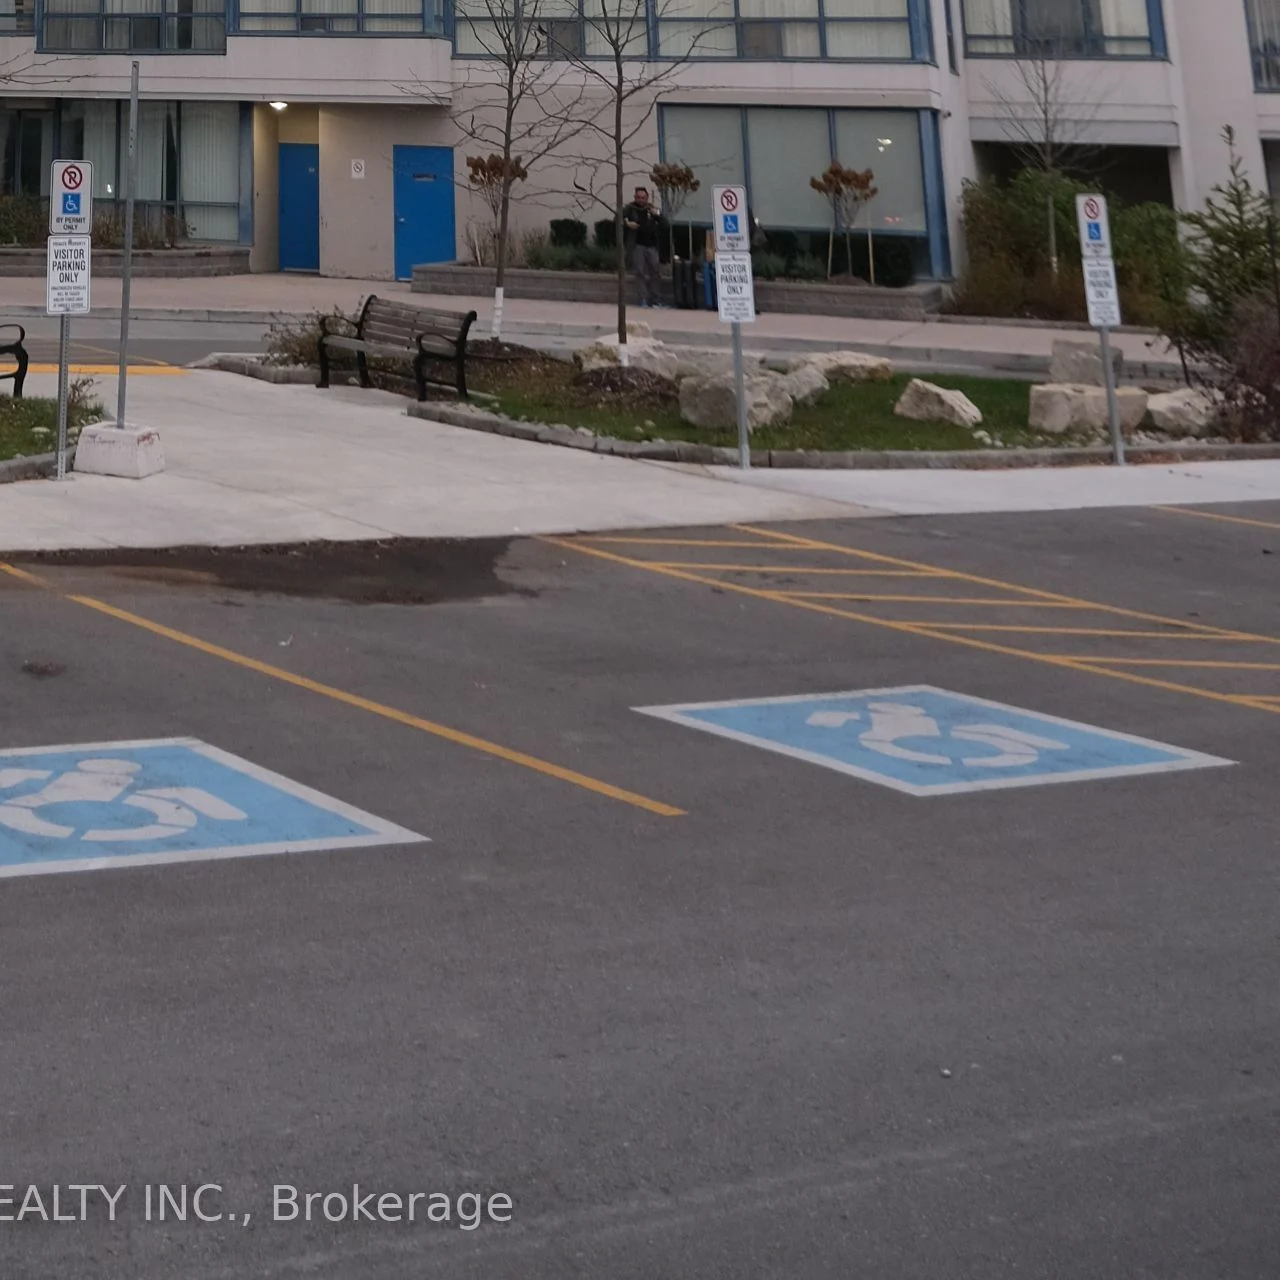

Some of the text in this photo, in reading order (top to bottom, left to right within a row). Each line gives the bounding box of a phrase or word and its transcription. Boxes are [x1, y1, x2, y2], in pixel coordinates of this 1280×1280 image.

[54, 248, 85, 259] VISITOR
[52, 260, 86, 271] PARKING
[720, 263, 746, 273] VISITOR
[59, 272, 79, 283] ONLY
[720, 274, 748, 284] PARKING
[726, 285, 742, 295] ONLY
